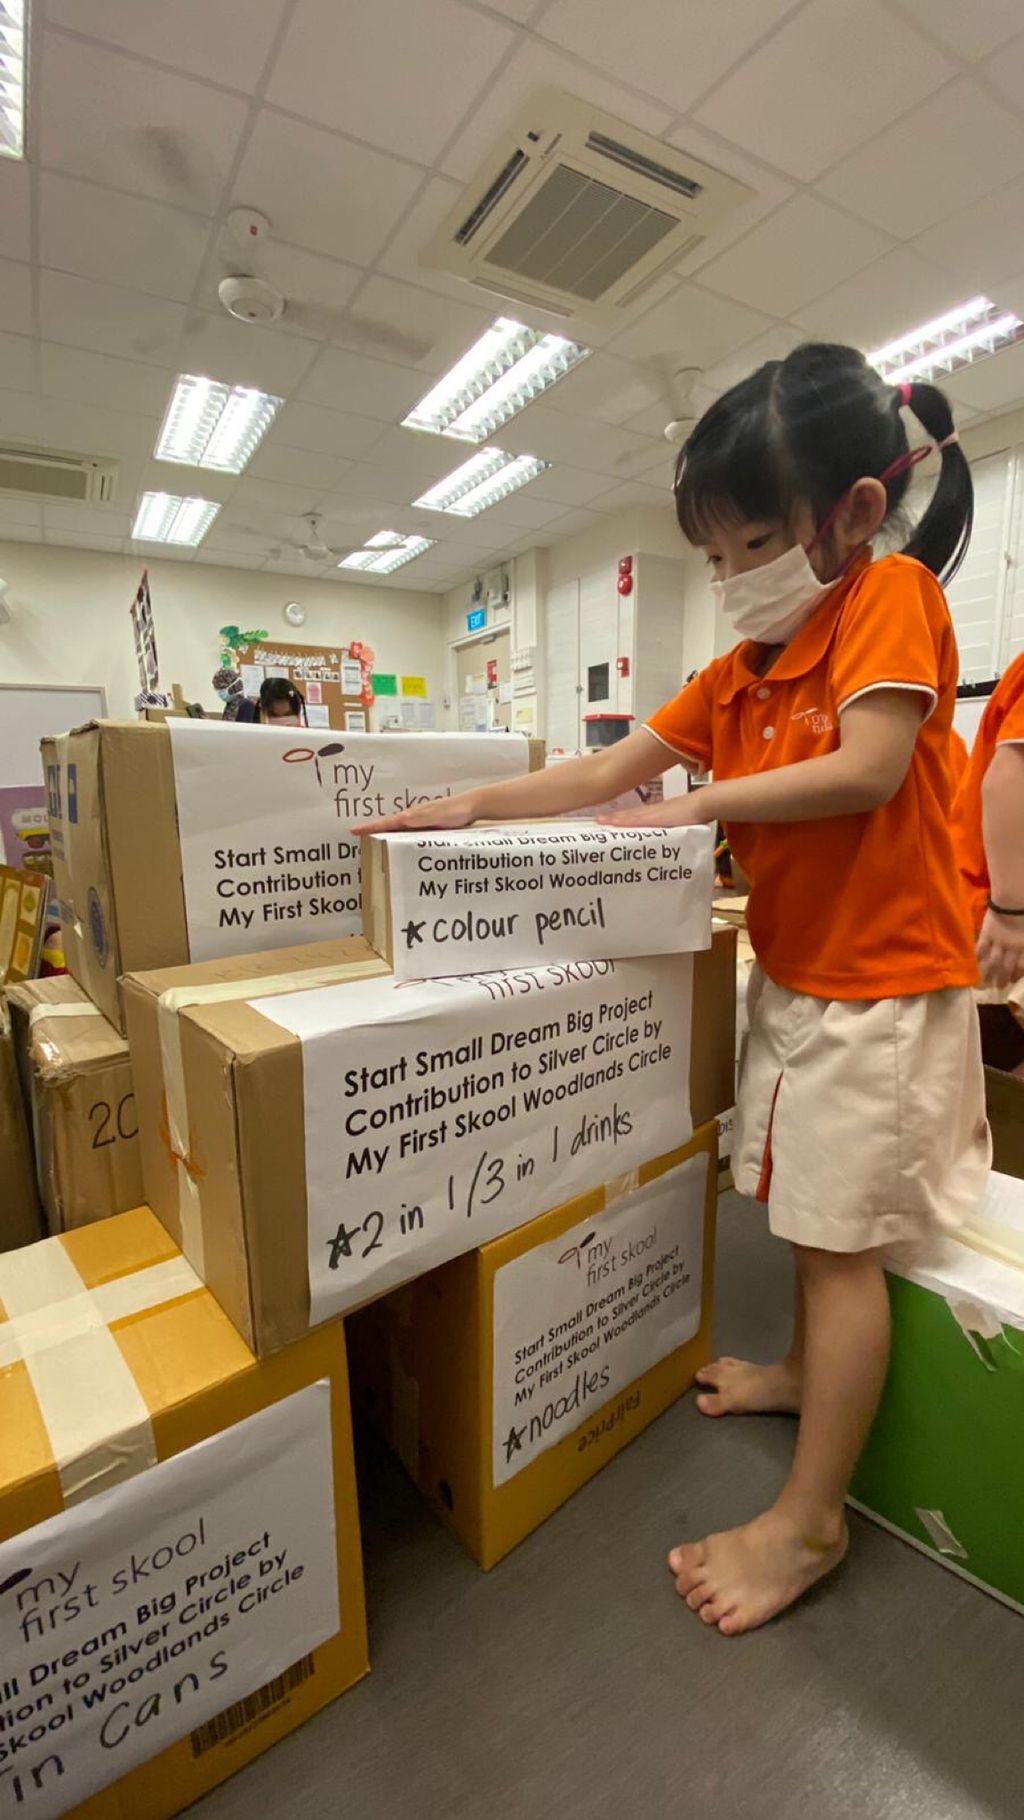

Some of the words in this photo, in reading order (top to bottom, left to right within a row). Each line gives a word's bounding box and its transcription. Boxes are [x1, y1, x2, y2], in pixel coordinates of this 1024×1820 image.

[333, 763, 375, 791] my
[334, 788, 385, 817] first
[214, 847, 266, 870] Start
[273, 843, 331, 864] Small
[216, 870, 352, 898] Contribution
[418, 851, 534, 873] Contribution
[540, 851, 556, 866] to
[561, 848, 605, 865] Silver
[610, 845, 656, 862] Circle
[661, 844, 681, 861] by
[418, 880, 448, 899] My
[454, 877, 489, 894] First
[494, 875, 543, 893] Skool
[549, 868, 642, 889] Woodlands
[646, 866, 693, 882] Circle
[218, 907, 254, 929] My
[263, 899, 302, 923] First
[309, 893, 362, 916] Skool
[432, 911, 520, 943] colour
[535, 897, 606, 945] pencil
[344, 1060, 407, 1098] Start
[415, 1037, 483, 1078] Small
[490, 1021, 561, 1054] Dream
[566, 1008, 595, 1040] Big
[598, 991, 654, 1028] Project
[344, 1072, 505, 1137] Contribution
[510, 1061, 532, 1085] to
[537, 1044, 587, 1076] Silver
[592, 1029, 638, 1057] Circle
[643, 1017, 663, 1045] by
[345, 1145, 390, 1180] My
[399, 1125, 448, 1159] First
[454, 1098, 517, 1138] Skool
[522, 1061, 625, 1112] Woodlands
[628, 1042, 672, 1073] Circle
[361, 1210, 384, 1258] 2
[400, 1203, 424, 1235] in
[516, 1154, 535, 1182] in
[570, 1102, 634, 1158] drinks
[586, 1261, 618, 1289] first
[620, 1225, 658, 1264] skool
[587, 1236, 613, 1264] my
[514, 1334, 545, 1365] Start
[548, 1311, 583, 1343] Small
[585, 1286, 626, 1317] Dream
[628, 1272, 644, 1292] Big
[645, 1246, 680, 1278] Project
[514, 1322, 594, 1384] Contribution
[596, 1312, 609, 1330] to
[612, 1292, 639, 1321] Silver
[642, 1270, 671, 1298] Circle
[671, 1261, 686, 1281] by
[514, 1384, 535, 1407] My
[539, 1363, 564, 1389] First
[567, 1337, 600, 1368] Skool
[603, 1293, 661, 1344] Woodlands
[662, 1272, 691, 1300] Circle
[529, 1364, 611, 1443] noodles
[16, 1561, 81, 1612] my
[19, 1584, 99, 1643] first
[111, 1516, 206, 1595] skool
[29, 1621, 128, 1687] Dream
[136, 1592, 177, 1625] Big
[185, 1531, 271, 1598] Project
[63, 1672, 91, 1695] to
[100, 1623, 170, 1675] Silver
[178, 1573, 250, 1625] Circle
[258, 1549, 288, 1584] by
[82, 1612, 230, 1709] Woodlands
[239, 1564, 305, 1614] Circle
[99, 1650, 229, 1749] Cans
